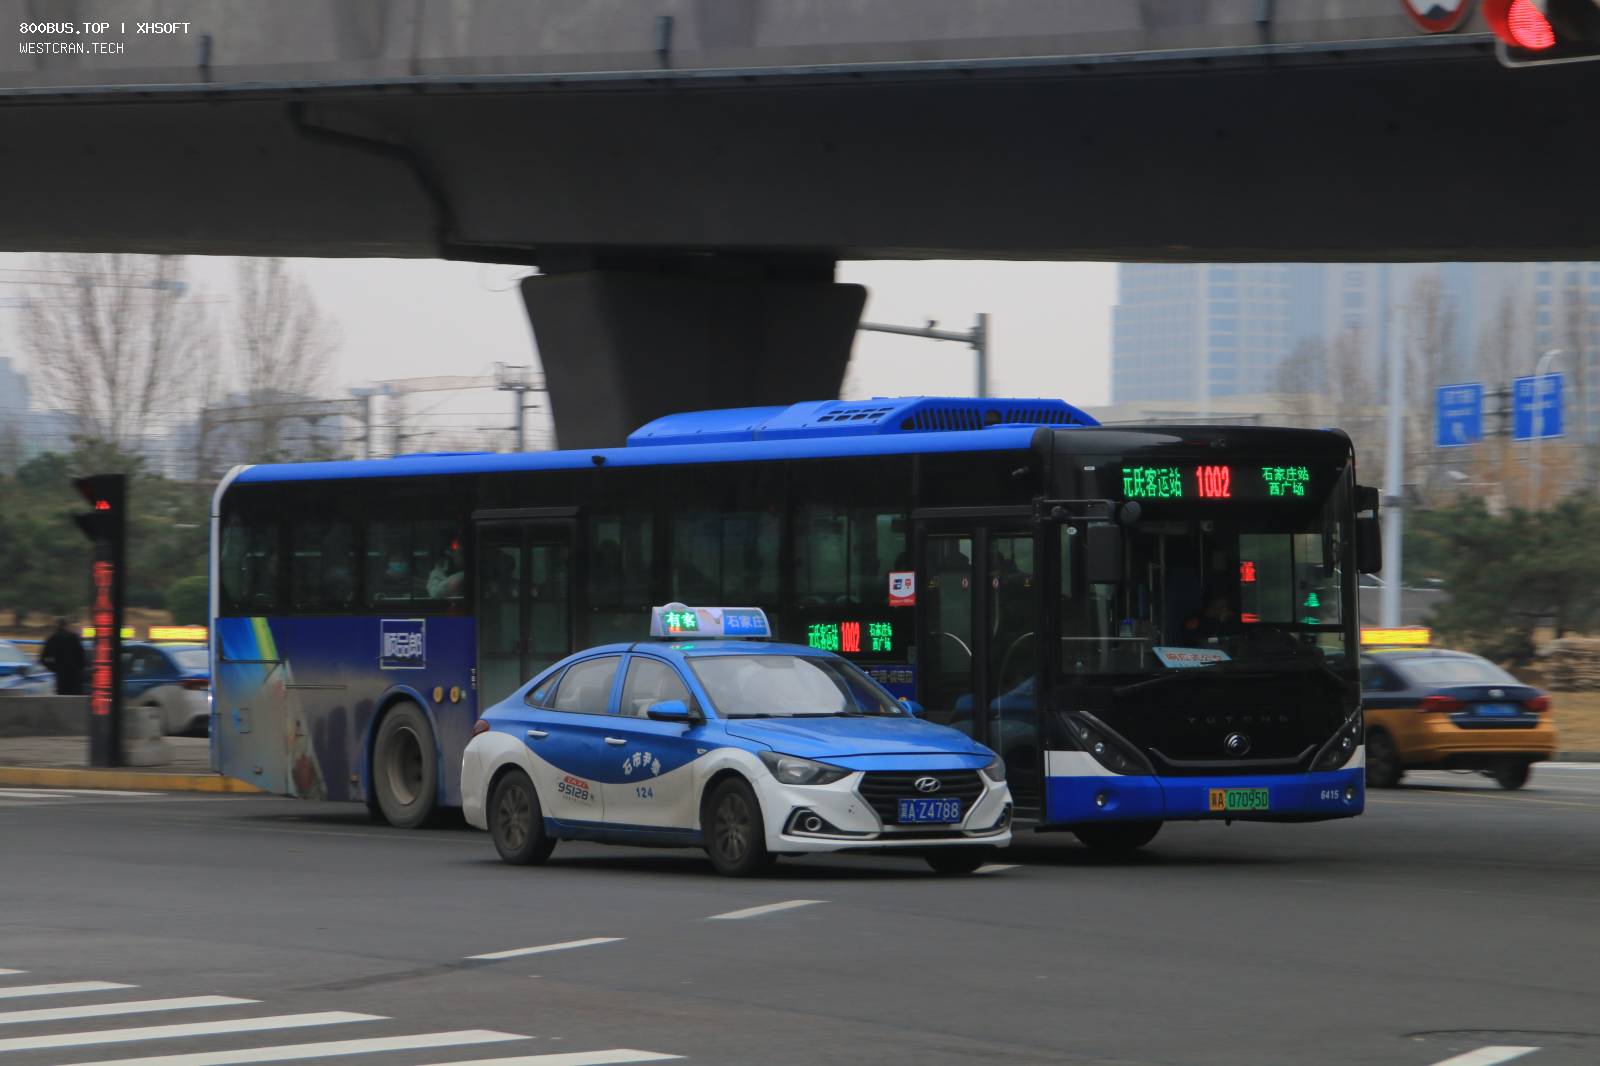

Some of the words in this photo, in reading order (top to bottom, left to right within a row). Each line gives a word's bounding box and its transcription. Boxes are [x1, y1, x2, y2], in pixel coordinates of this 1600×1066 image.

[1195, 465, 1231, 498] 1002
[1262, 466, 1310, 481] 石家庄站
[1122, 466, 1183, 498] 元氏客运站
[1268, 481, 1306, 497] 西广场
[558, 783, 588, 800] 95128
[636, 786, 654, 798] 124
[1320, 790, 1340, 800] 6415
